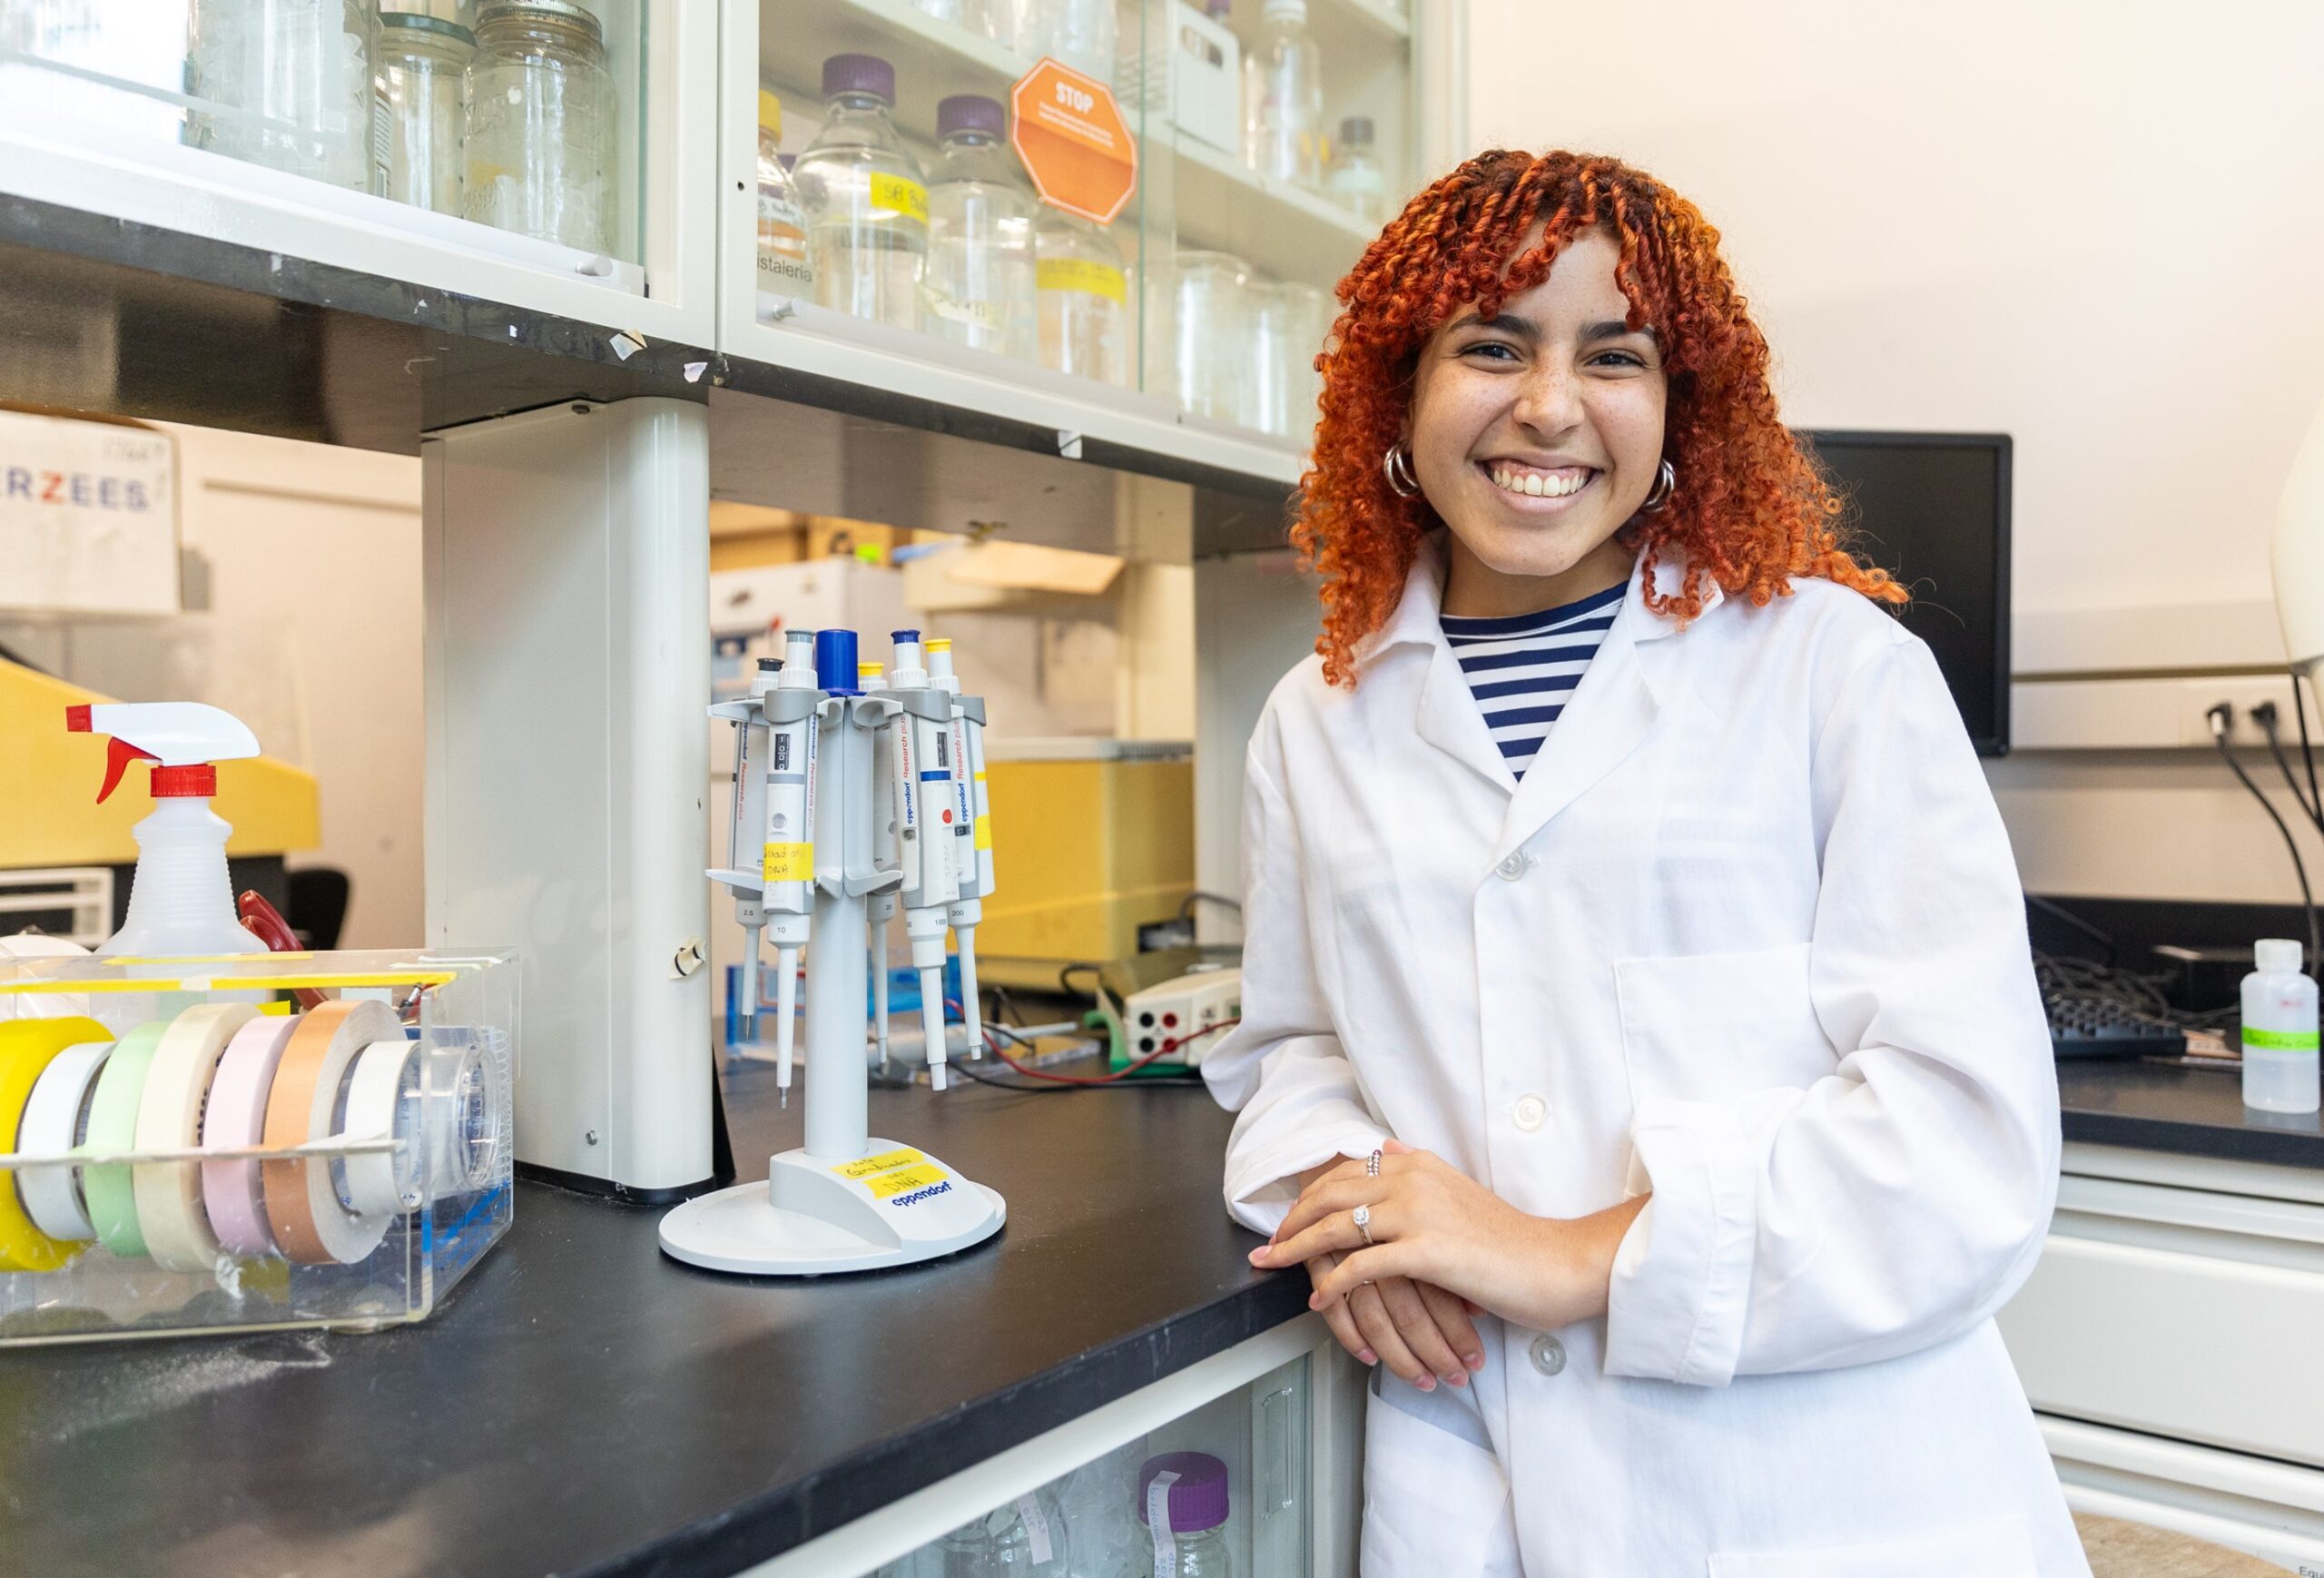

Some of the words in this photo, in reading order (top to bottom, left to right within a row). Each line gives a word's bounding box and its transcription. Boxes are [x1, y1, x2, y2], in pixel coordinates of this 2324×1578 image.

[1055, 81, 1094, 114] STOP
[1, 466, 149, 512] RZEES
[901, 736, 910, 778] Research
[954, 740, 964, 780] Research
[904, 782, 914, 824] eppendorf
[958, 783, 970, 822] eppendorf
[776, 926, 786, 934] 10
[882, 1176, 923, 1192] DNA
[891, 1181, 952, 1207] eppendorf
[2299, 1565, 2324, 1578] Equ
